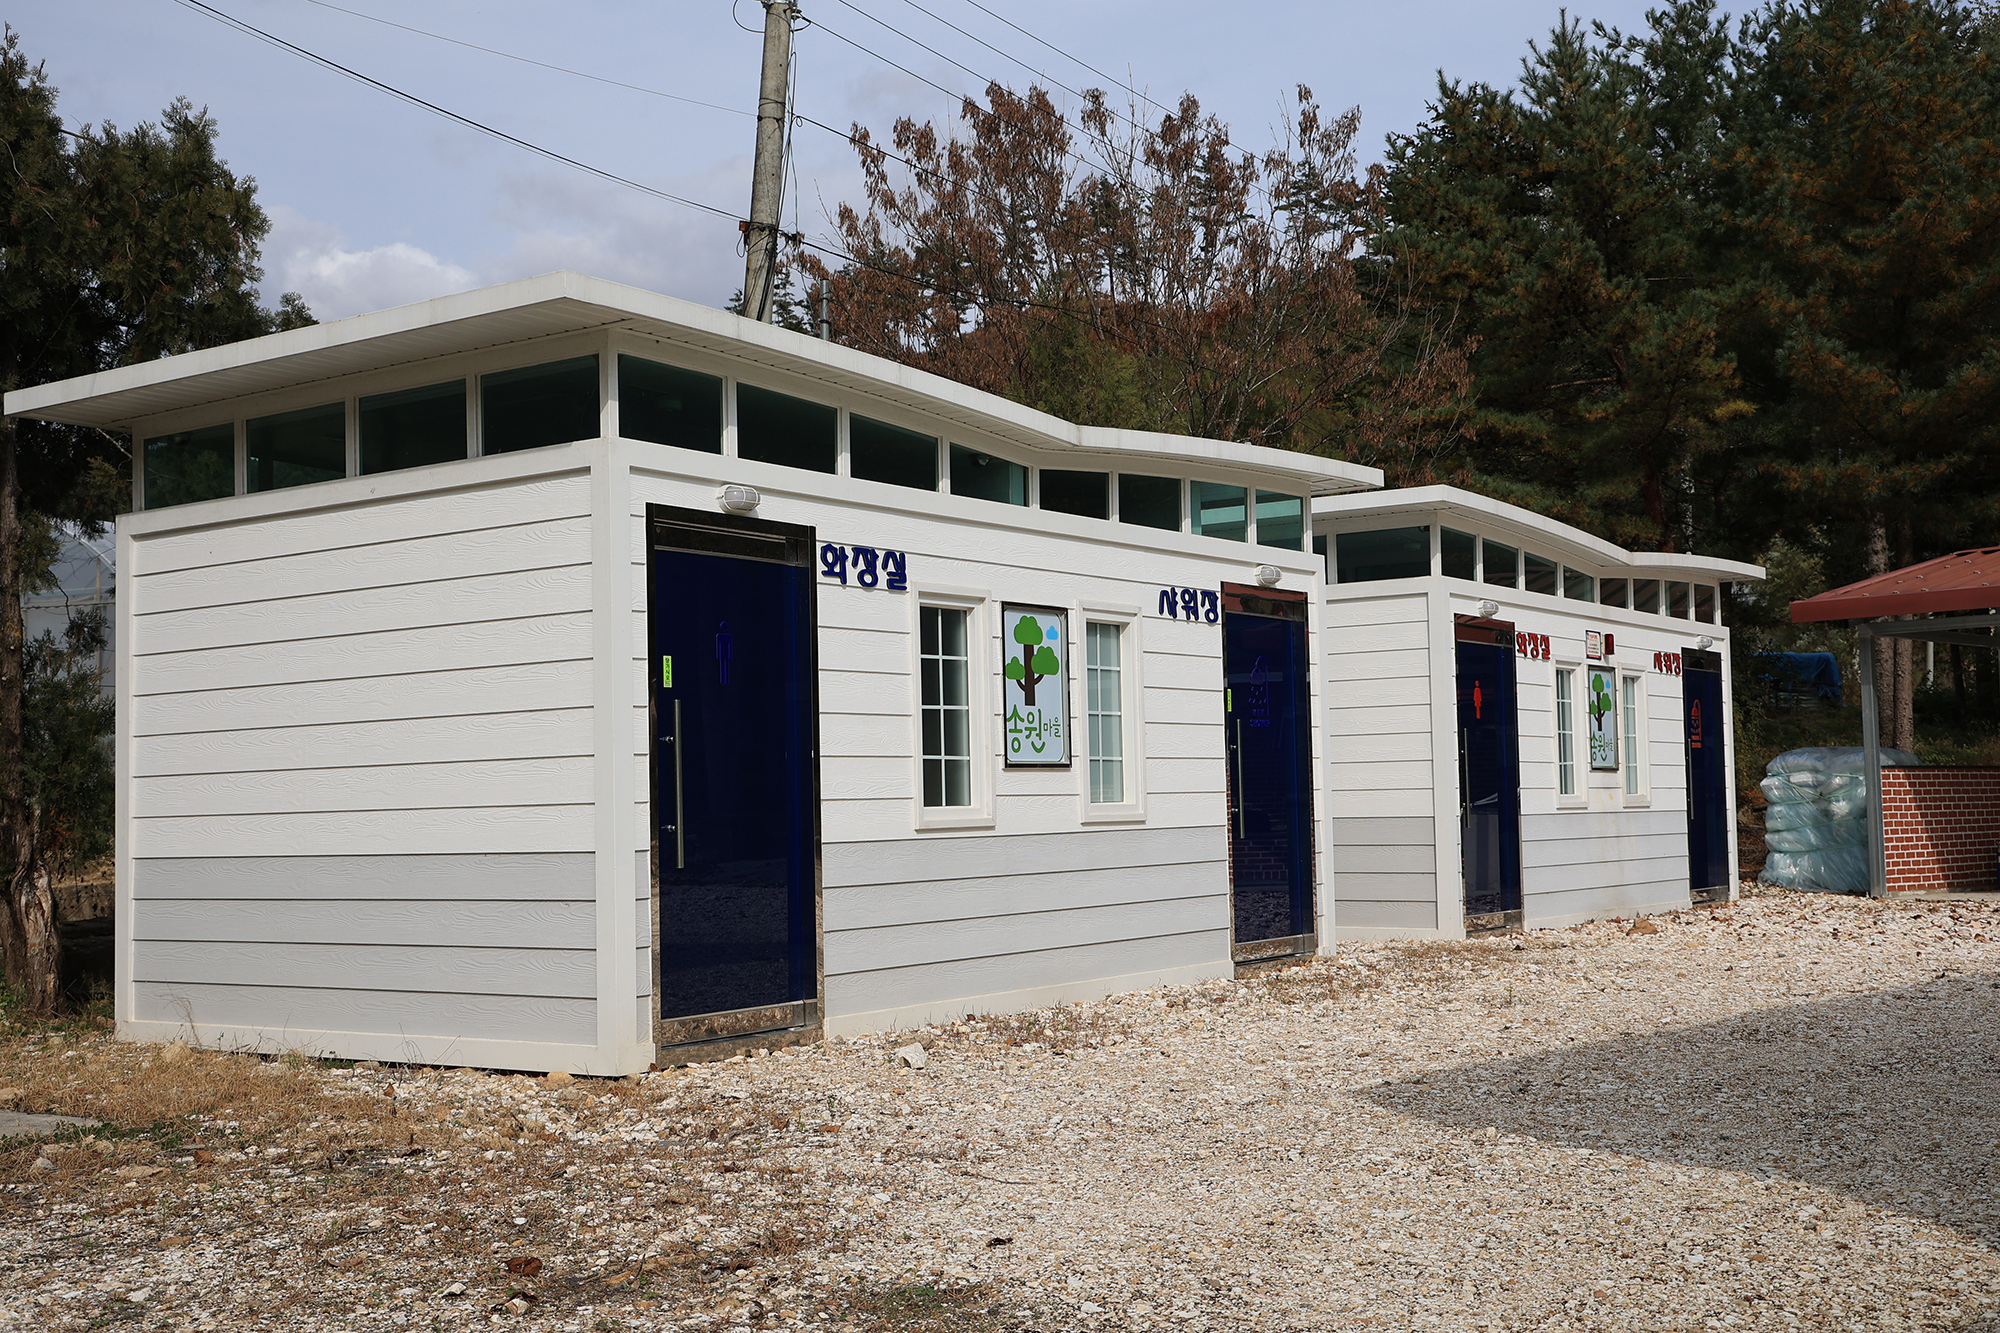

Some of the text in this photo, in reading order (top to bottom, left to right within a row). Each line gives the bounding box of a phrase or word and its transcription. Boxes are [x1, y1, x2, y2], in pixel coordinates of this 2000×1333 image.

[820, 543, 907, 590] 화장실
[1159, 586, 1219, 623] 샤워장
[1516, 632, 1551, 660] 화장실
[1653, 651, 1682, 675] 샤워장
[1006, 704, 1061, 753] 송원 마을
